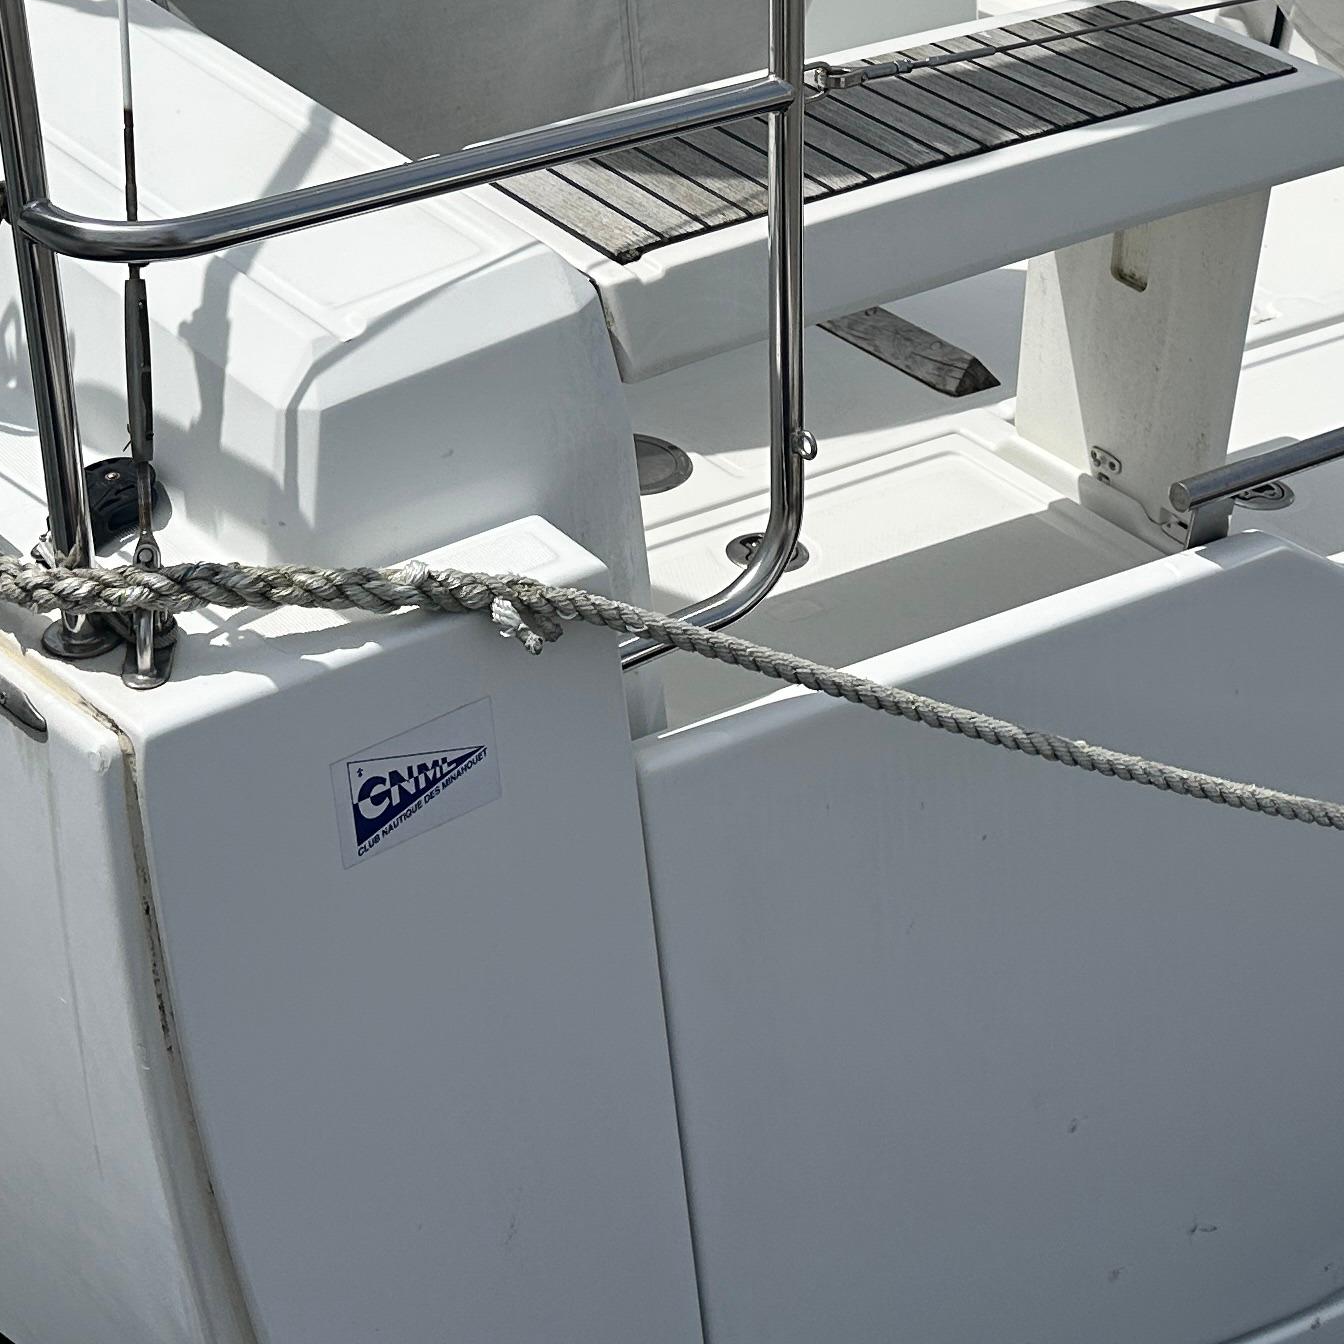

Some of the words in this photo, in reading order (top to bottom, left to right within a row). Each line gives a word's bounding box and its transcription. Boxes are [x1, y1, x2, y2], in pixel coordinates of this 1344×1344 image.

[358, 834, 381, 857] CLUB
[381, 799, 423, 838] NAUTIQUE
[424, 787, 441, 805] DES
[441, 747, 488, 790] MINAHOUET
